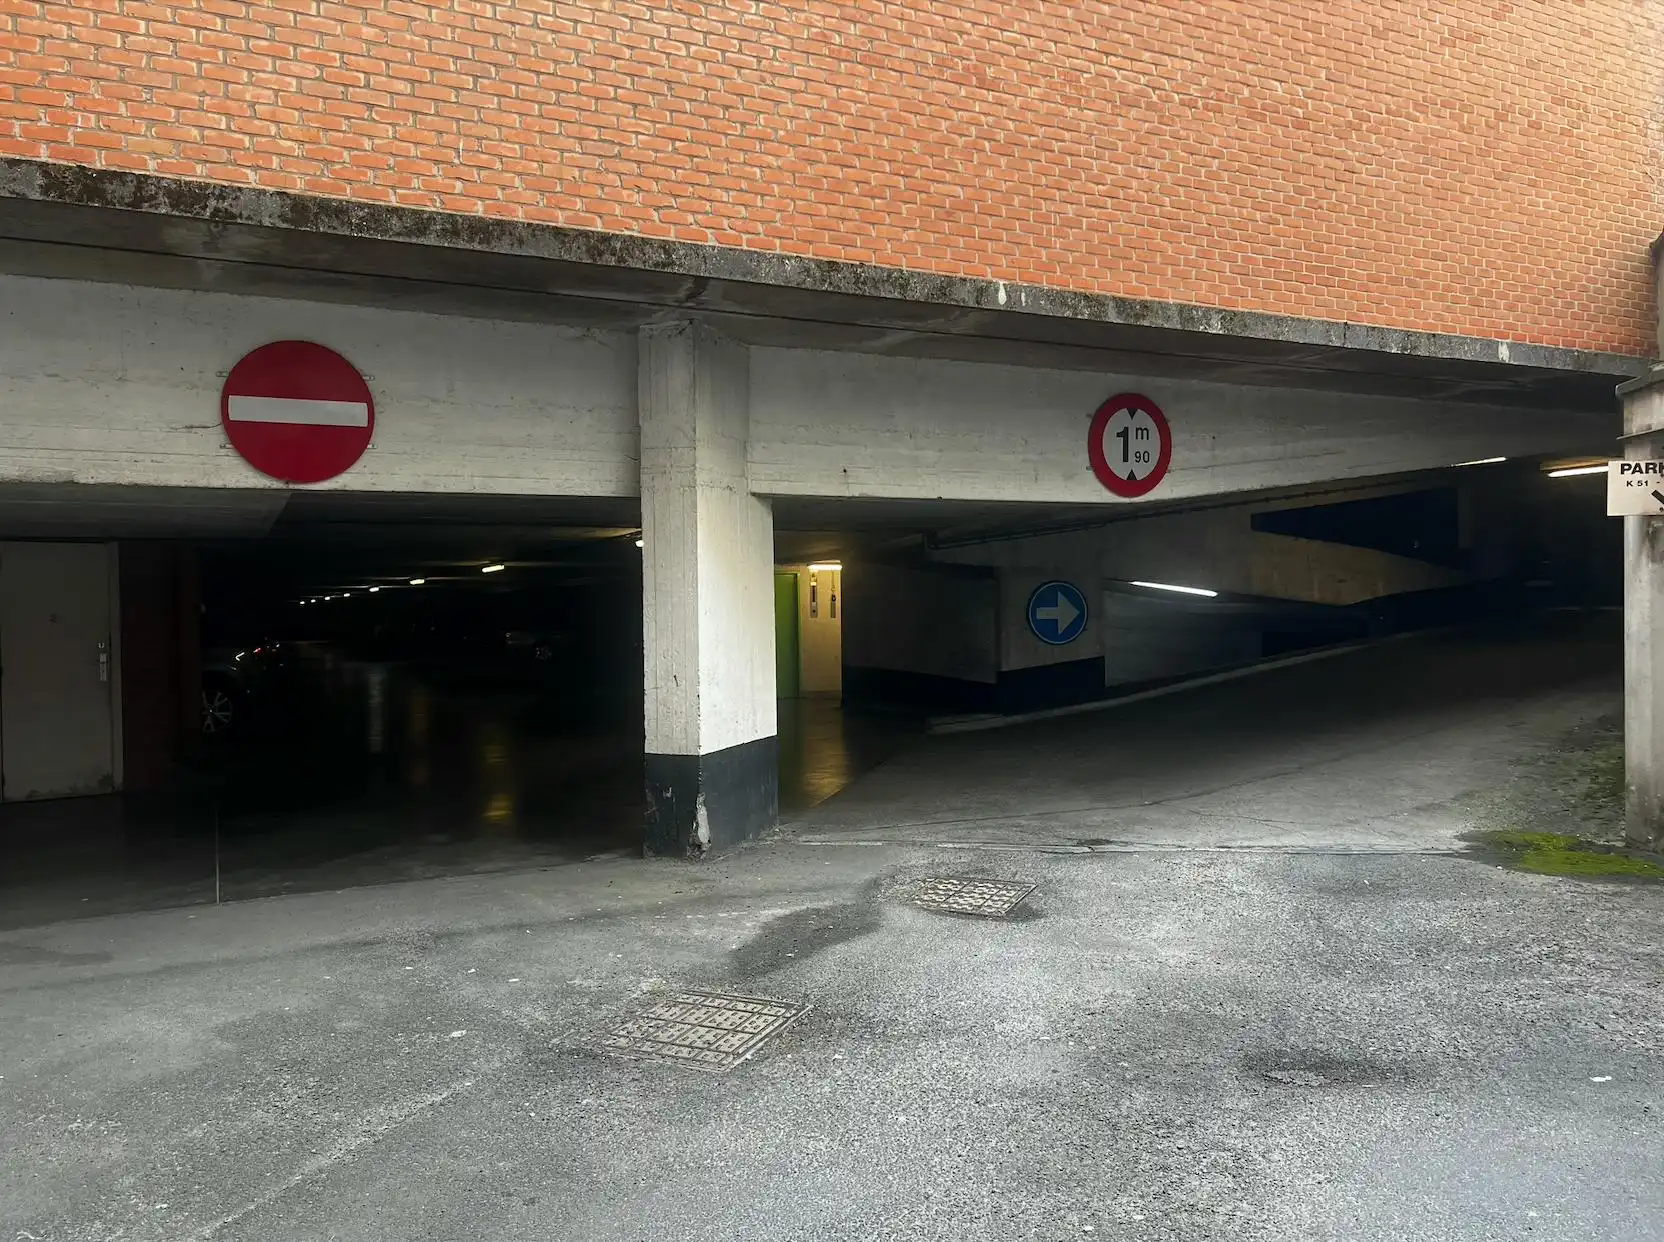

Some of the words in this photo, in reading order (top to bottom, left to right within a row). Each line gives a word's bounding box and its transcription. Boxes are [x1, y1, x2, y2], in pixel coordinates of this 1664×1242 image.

[1116, 426, 1129, 463] 1
[1135, 426, 1150, 441] m
[1134, 450, 1150, 464] 90
